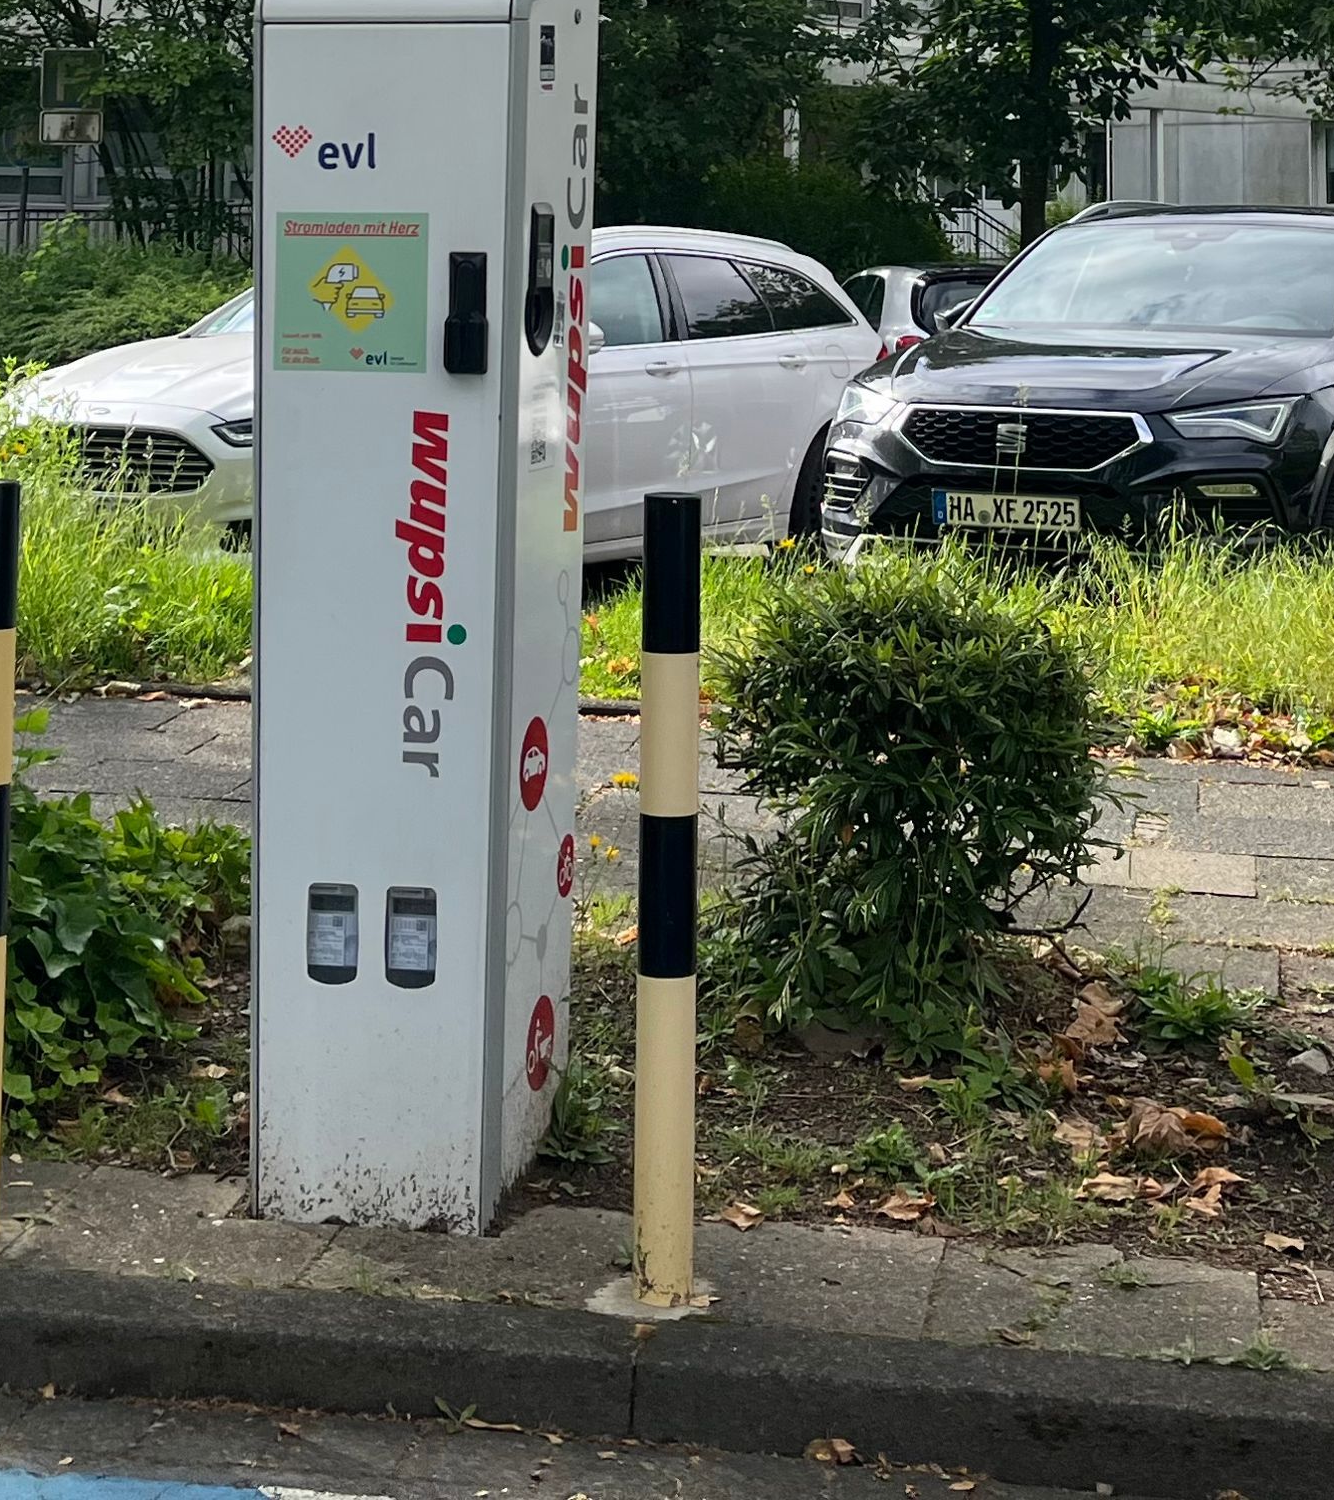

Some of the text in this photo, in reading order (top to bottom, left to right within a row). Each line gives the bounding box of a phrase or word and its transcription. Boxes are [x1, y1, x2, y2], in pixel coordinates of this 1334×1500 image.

[317, 132, 377, 170] evl
[284, 220, 420, 236] Stromladen mit Herz
[365, 350, 388, 366] evl
[949, 495, 1076, 527] HA XE 2525
